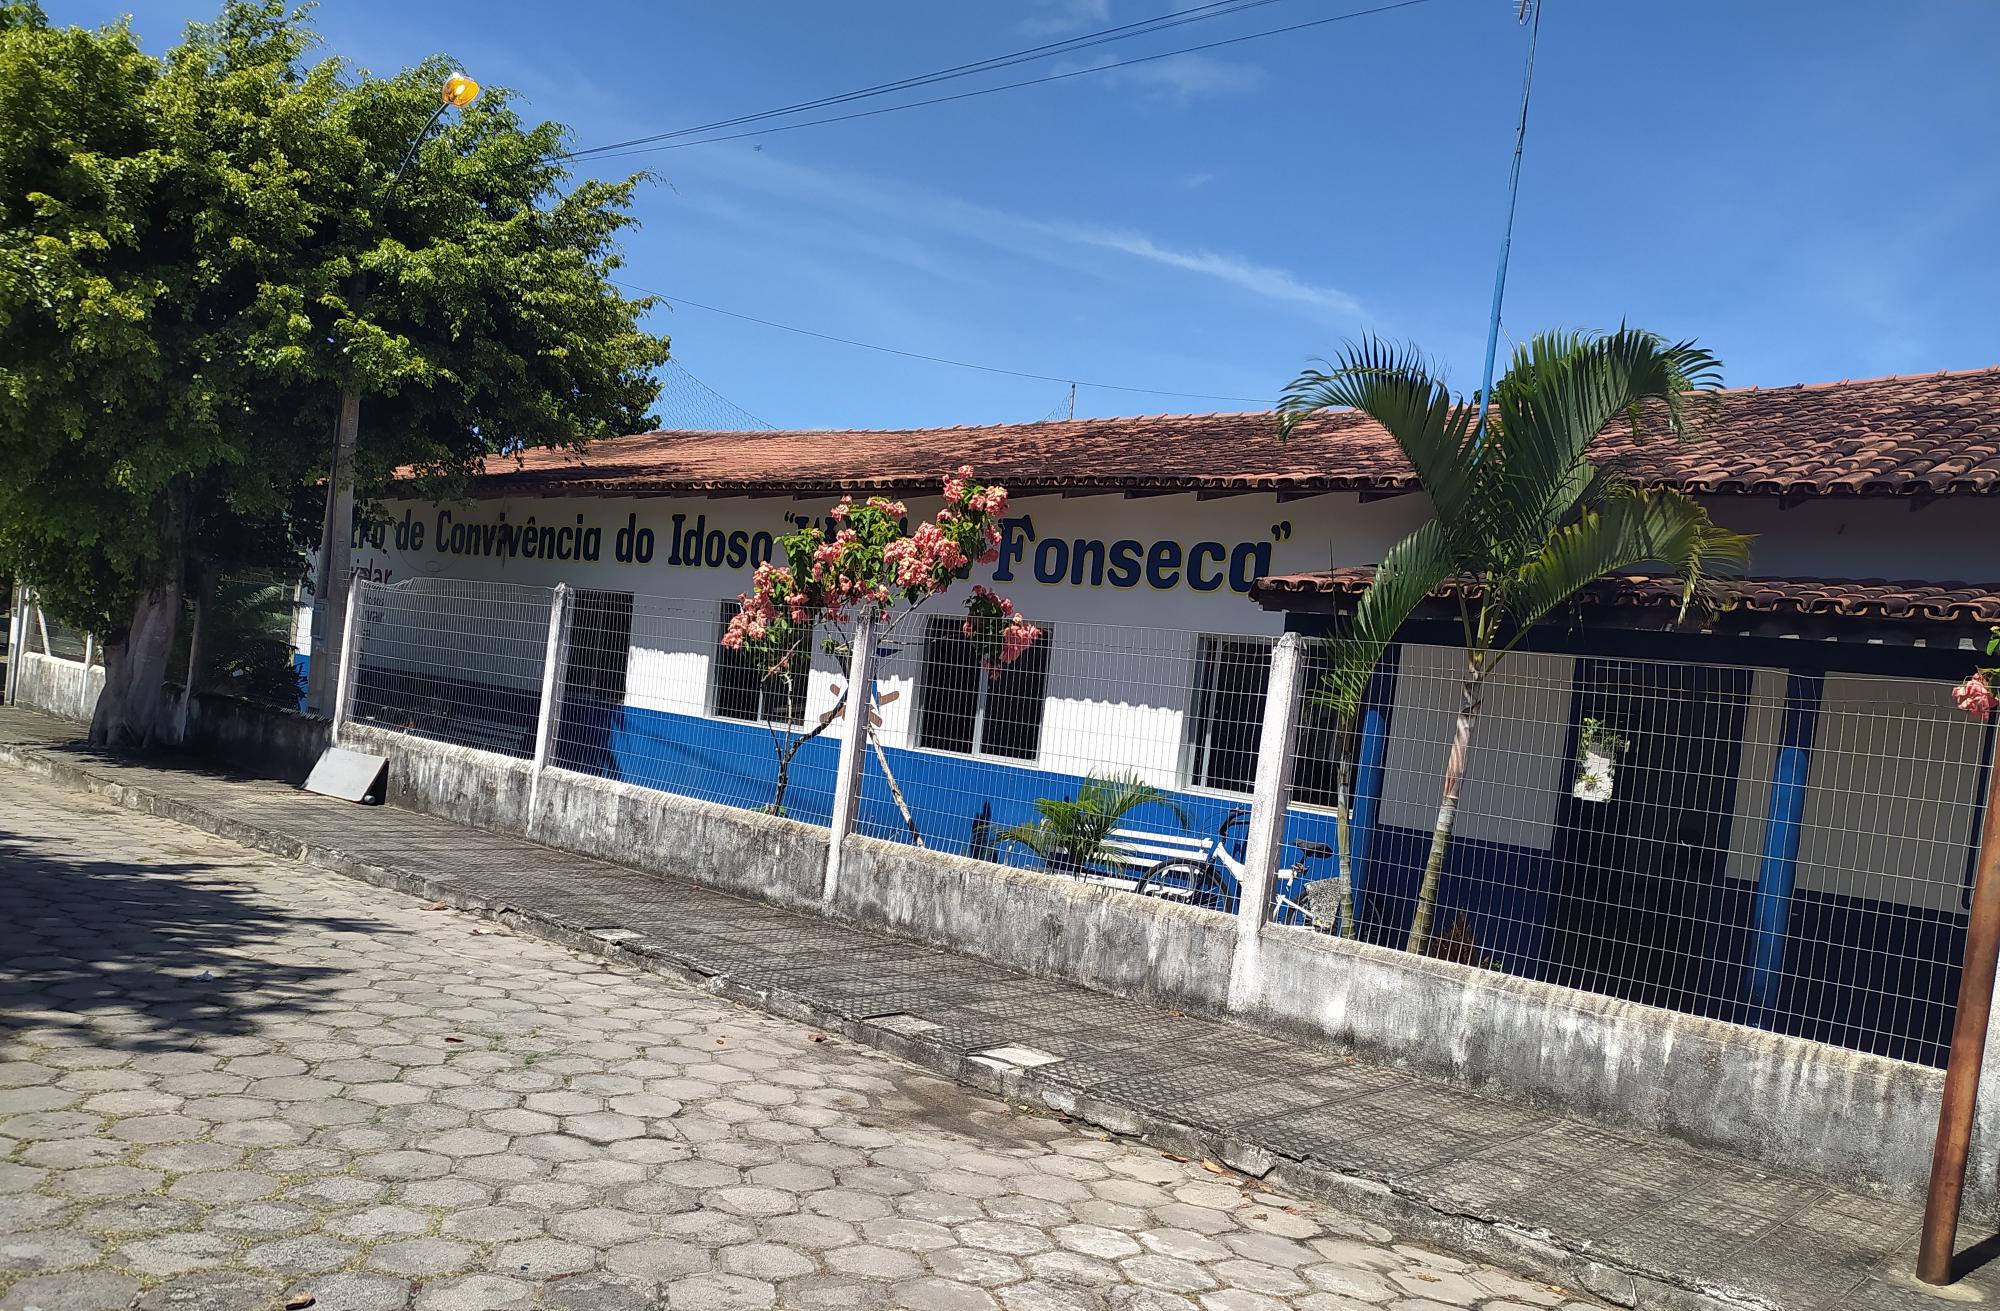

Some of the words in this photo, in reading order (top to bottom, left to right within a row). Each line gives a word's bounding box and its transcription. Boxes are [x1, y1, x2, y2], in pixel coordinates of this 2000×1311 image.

[395, 509, 425, 551] de
[435, 510, 602, 561] Convivência
[615, 512, 655, 564] do
[667, 513, 773, 569] Idoso
